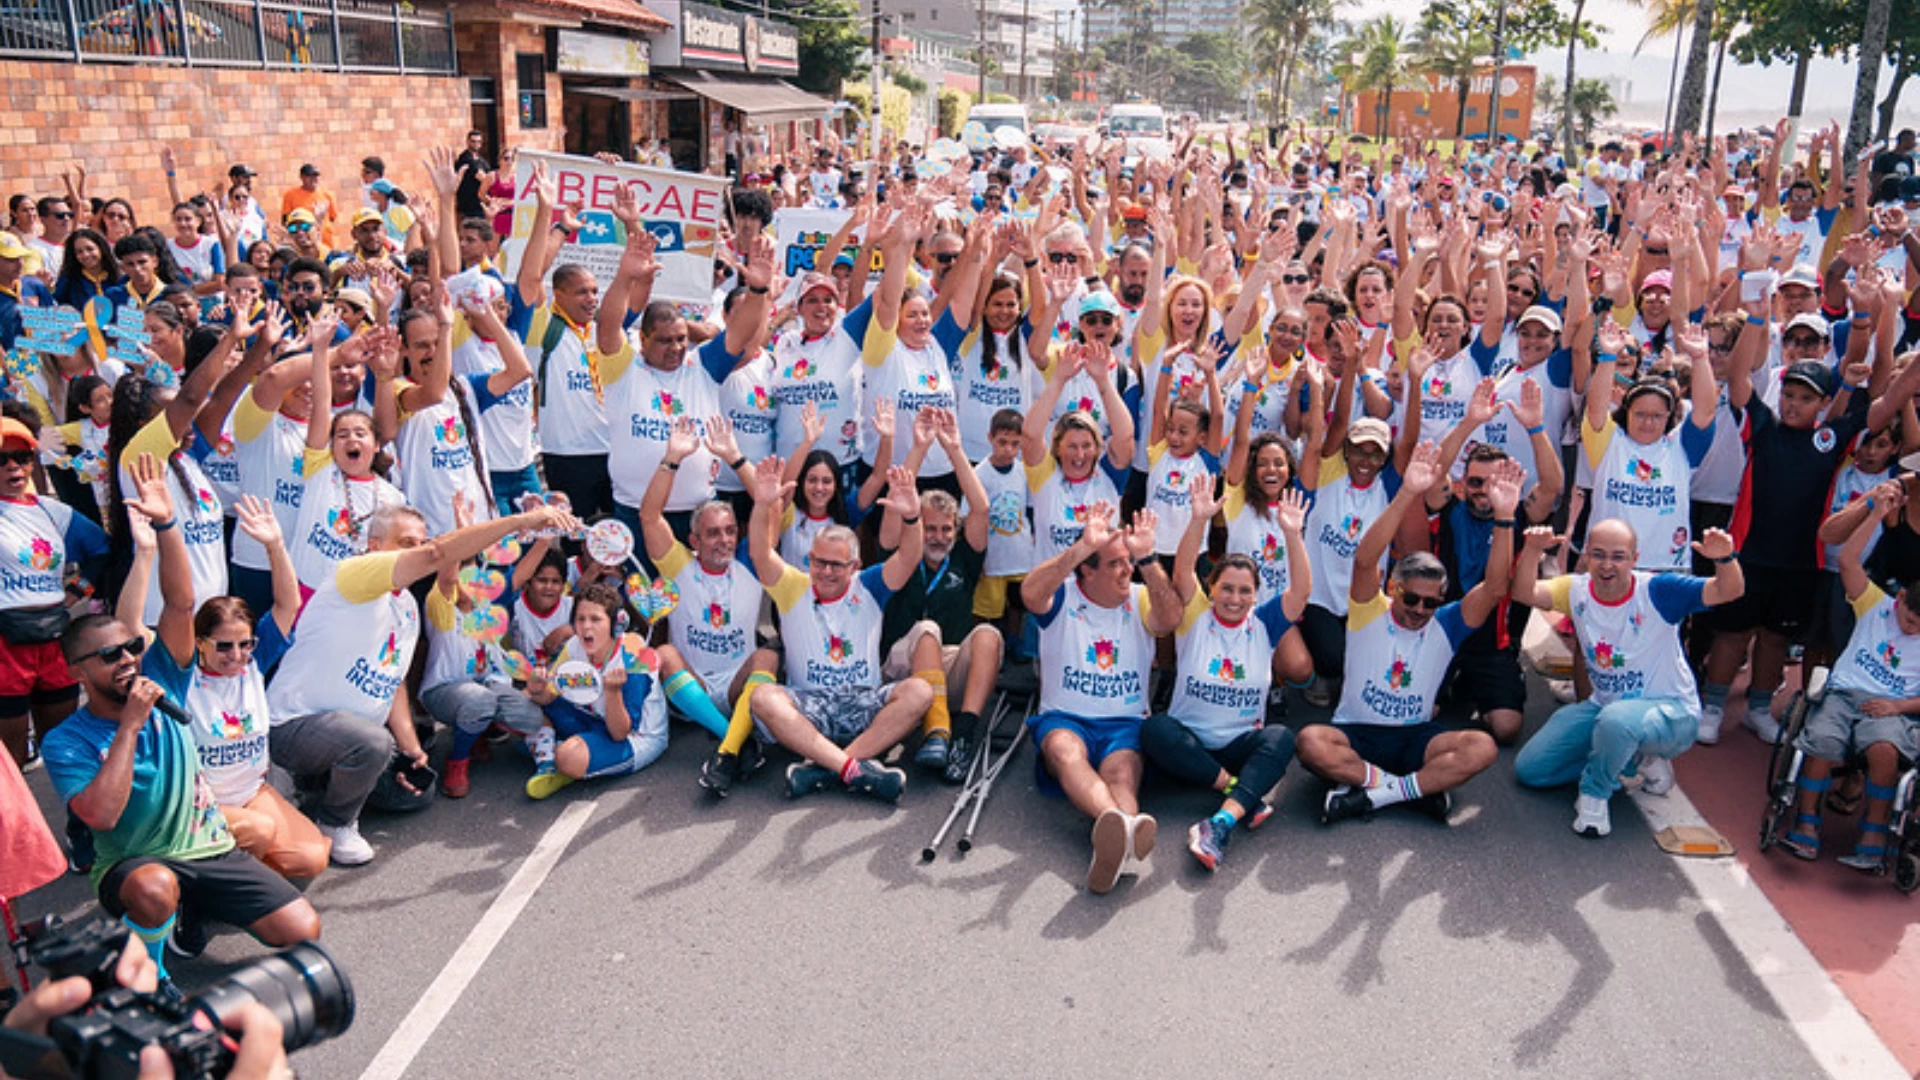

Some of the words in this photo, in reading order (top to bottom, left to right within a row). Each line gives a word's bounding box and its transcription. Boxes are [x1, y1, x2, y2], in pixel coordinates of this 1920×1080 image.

[1064, 665, 1140, 684] CAMINHADA
[1062, 678, 1142, 699] INCLUSIVA
[1186, 675, 1261, 696] CAMINHADA
[1185, 686, 1260, 708] INCLUSIVA
